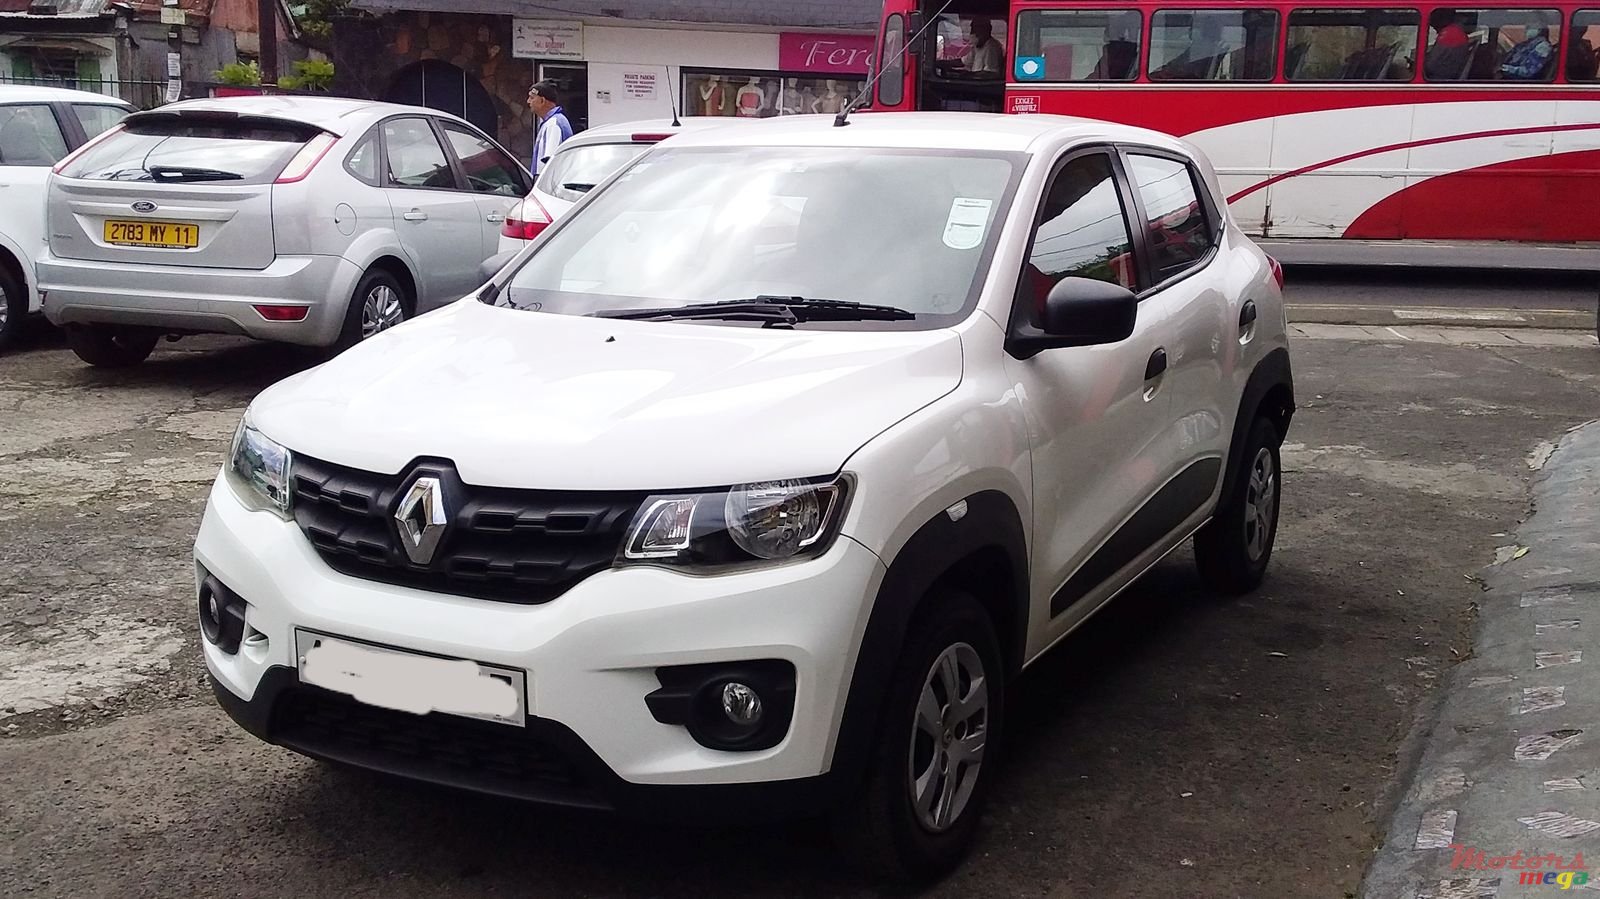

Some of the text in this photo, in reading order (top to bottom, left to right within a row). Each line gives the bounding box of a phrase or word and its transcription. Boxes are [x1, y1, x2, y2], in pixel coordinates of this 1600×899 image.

[111, 224, 190, 243] 2783 MY 11
